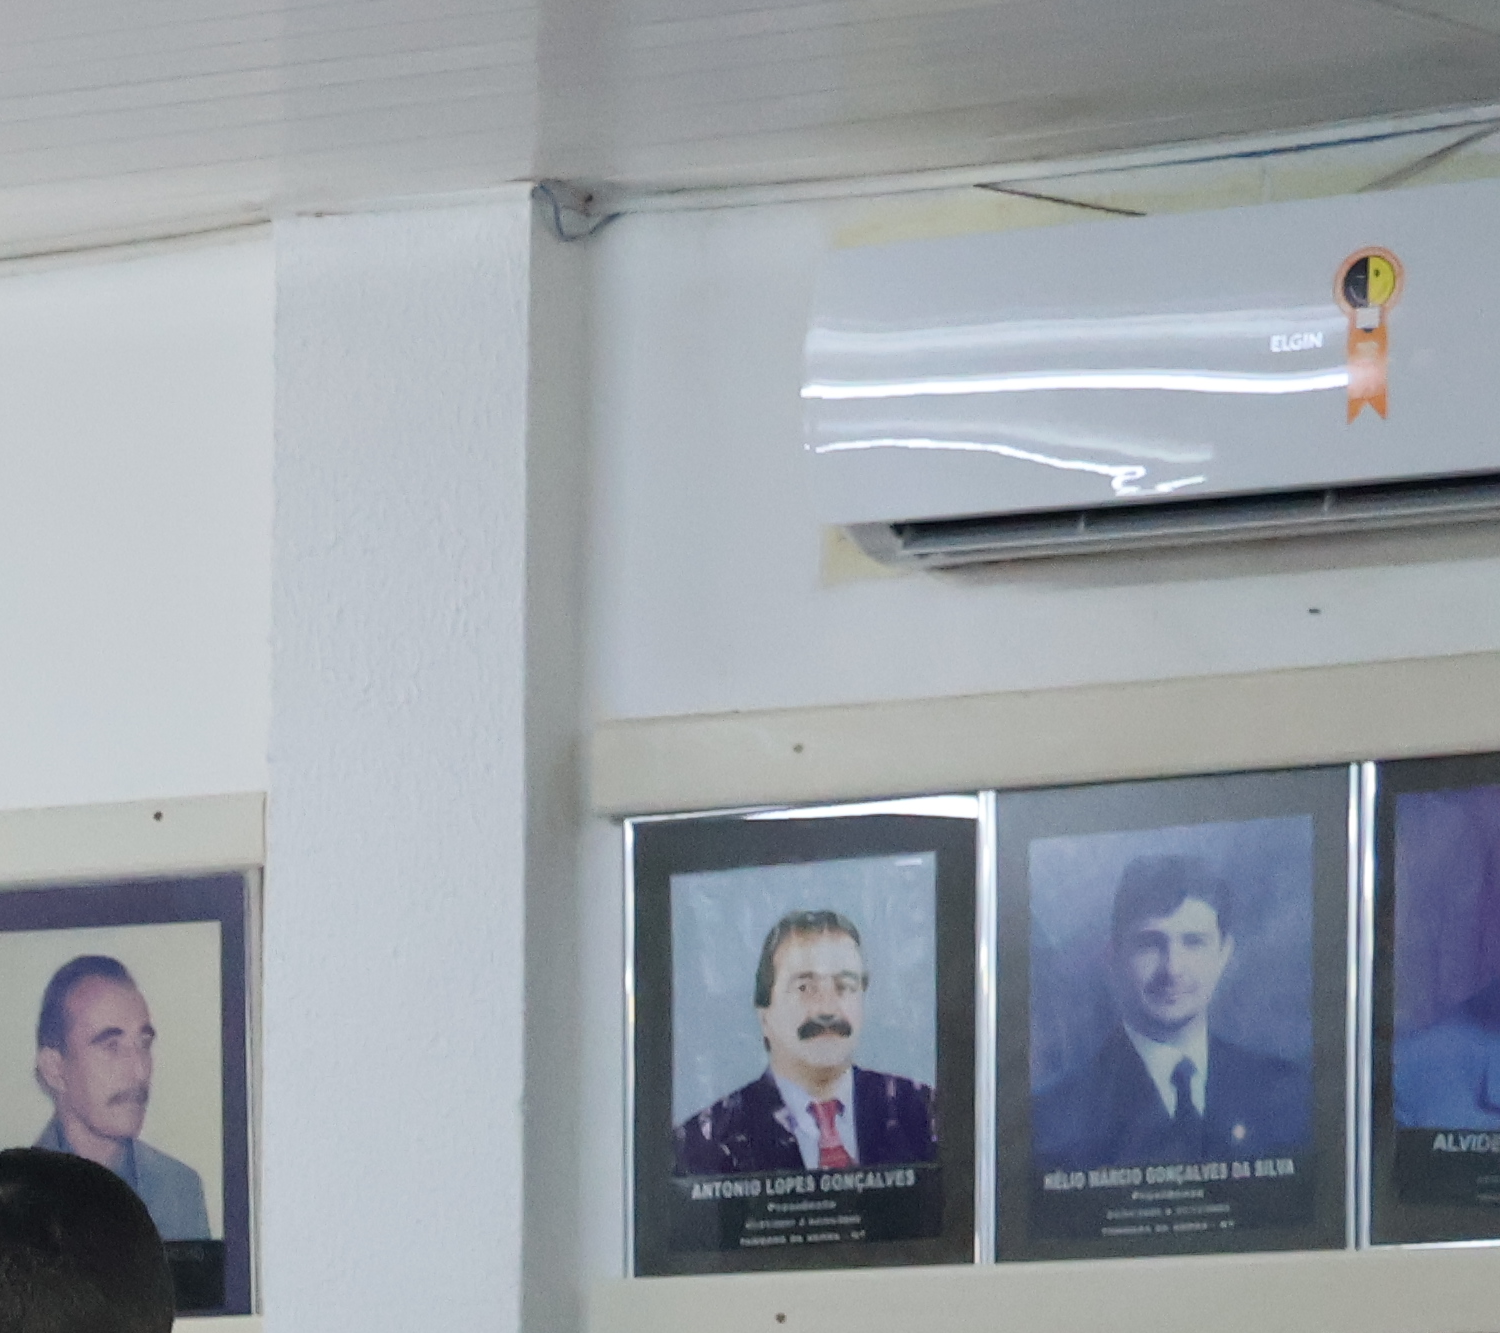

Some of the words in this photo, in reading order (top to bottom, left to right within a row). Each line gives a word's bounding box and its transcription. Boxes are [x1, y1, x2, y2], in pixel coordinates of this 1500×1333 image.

[1269, 331, 1323, 353] ELGIN
[691, 1179, 762, 1200] ANTONIO
[765, 1174, 816, 1196] LOPES
[819, 1168, 916, 1194] GONÇALVES
